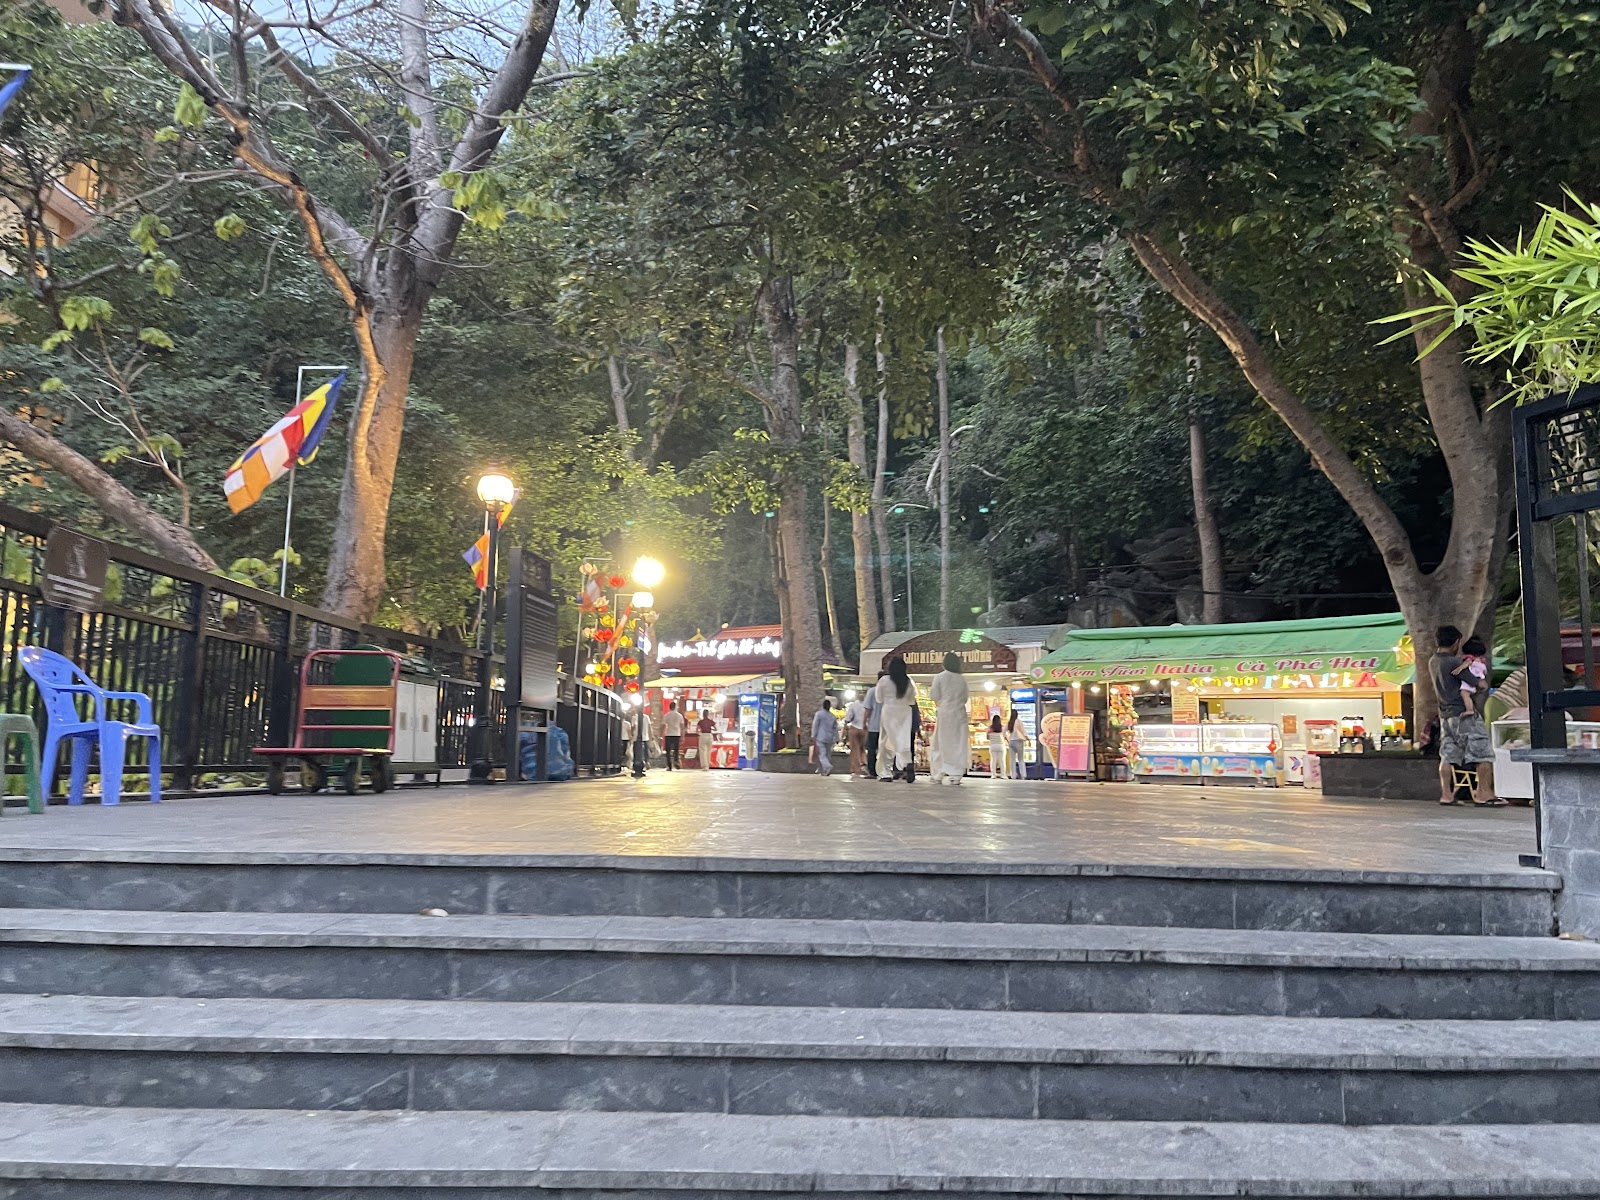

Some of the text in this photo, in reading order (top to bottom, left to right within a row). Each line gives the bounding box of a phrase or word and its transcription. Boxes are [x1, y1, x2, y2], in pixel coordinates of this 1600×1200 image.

[1051, 665, 1096, 678] Kem
[1153, 663, 1214, 675] Italia
[1236, 660, 1268, 672] Cà
